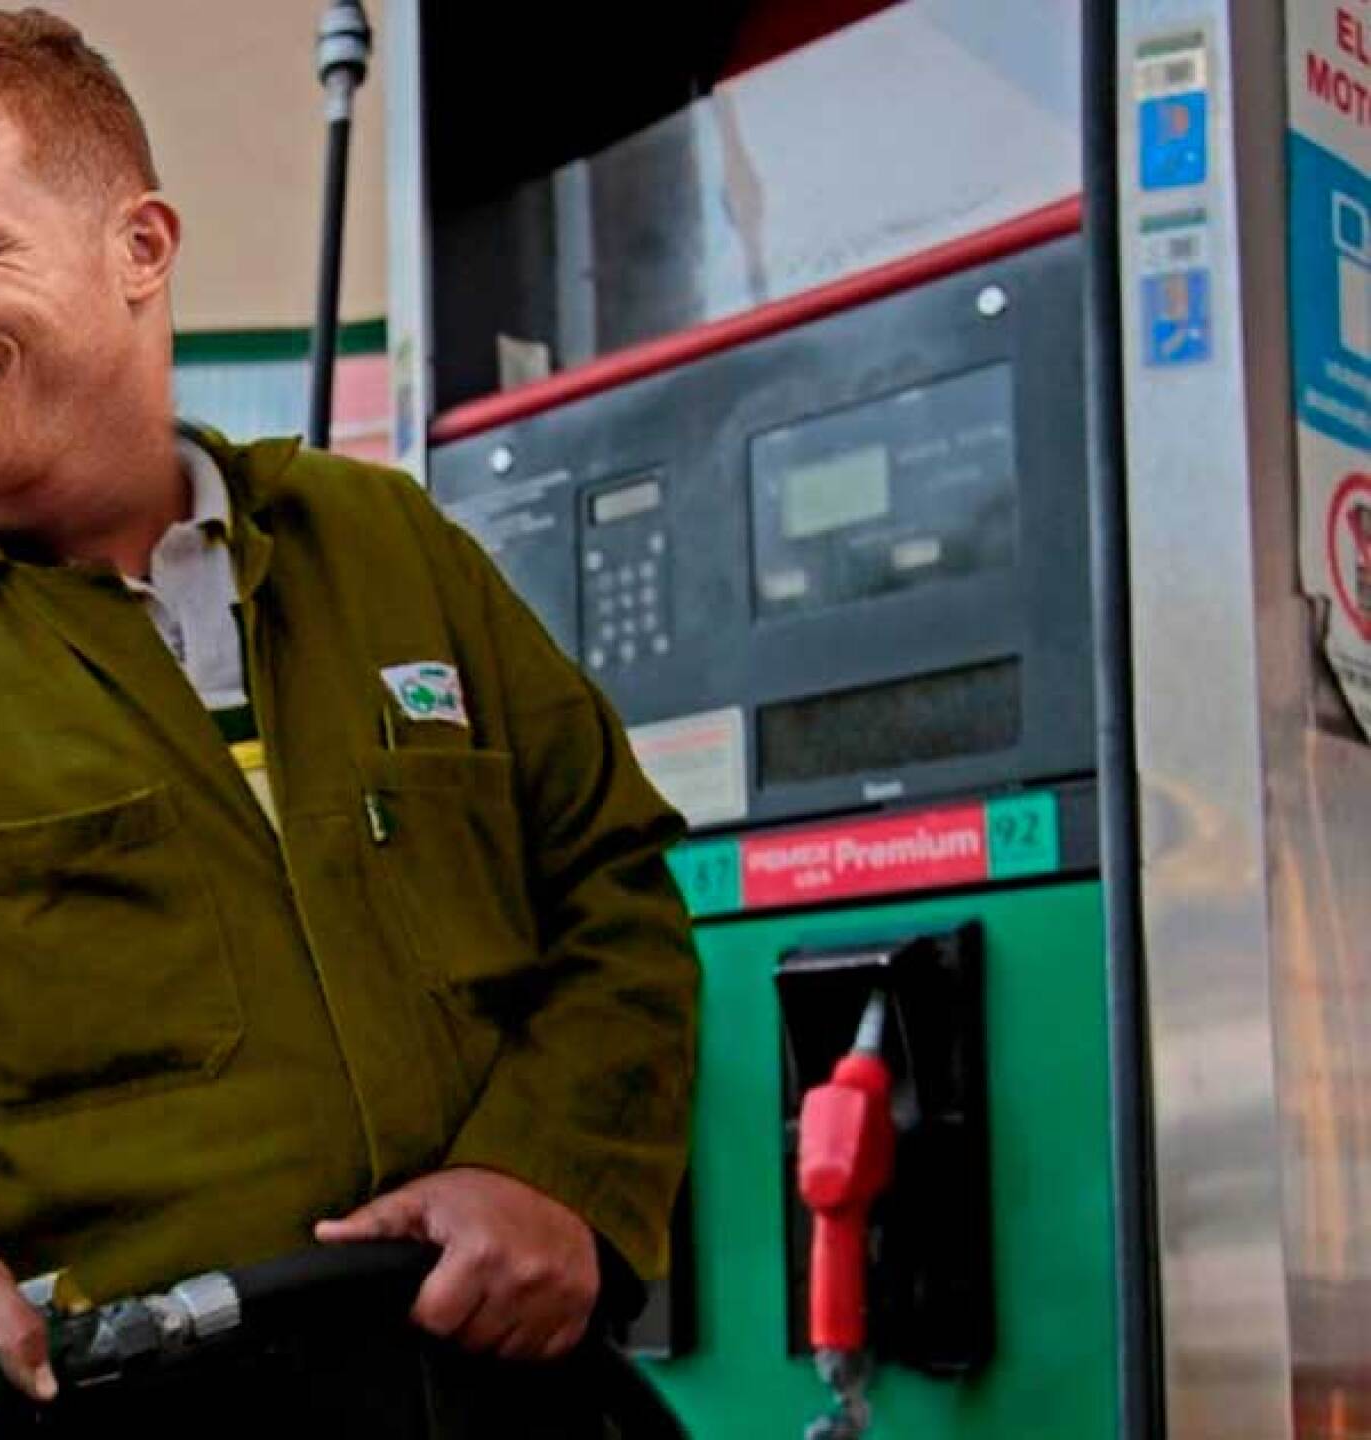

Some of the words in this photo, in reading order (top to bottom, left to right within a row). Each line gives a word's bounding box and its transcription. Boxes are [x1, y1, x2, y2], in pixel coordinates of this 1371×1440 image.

[1336, 8, 1371, 63] EL
[1306, 50, 1371, 126] MOT
[834, 826, 979, 873] Premium
